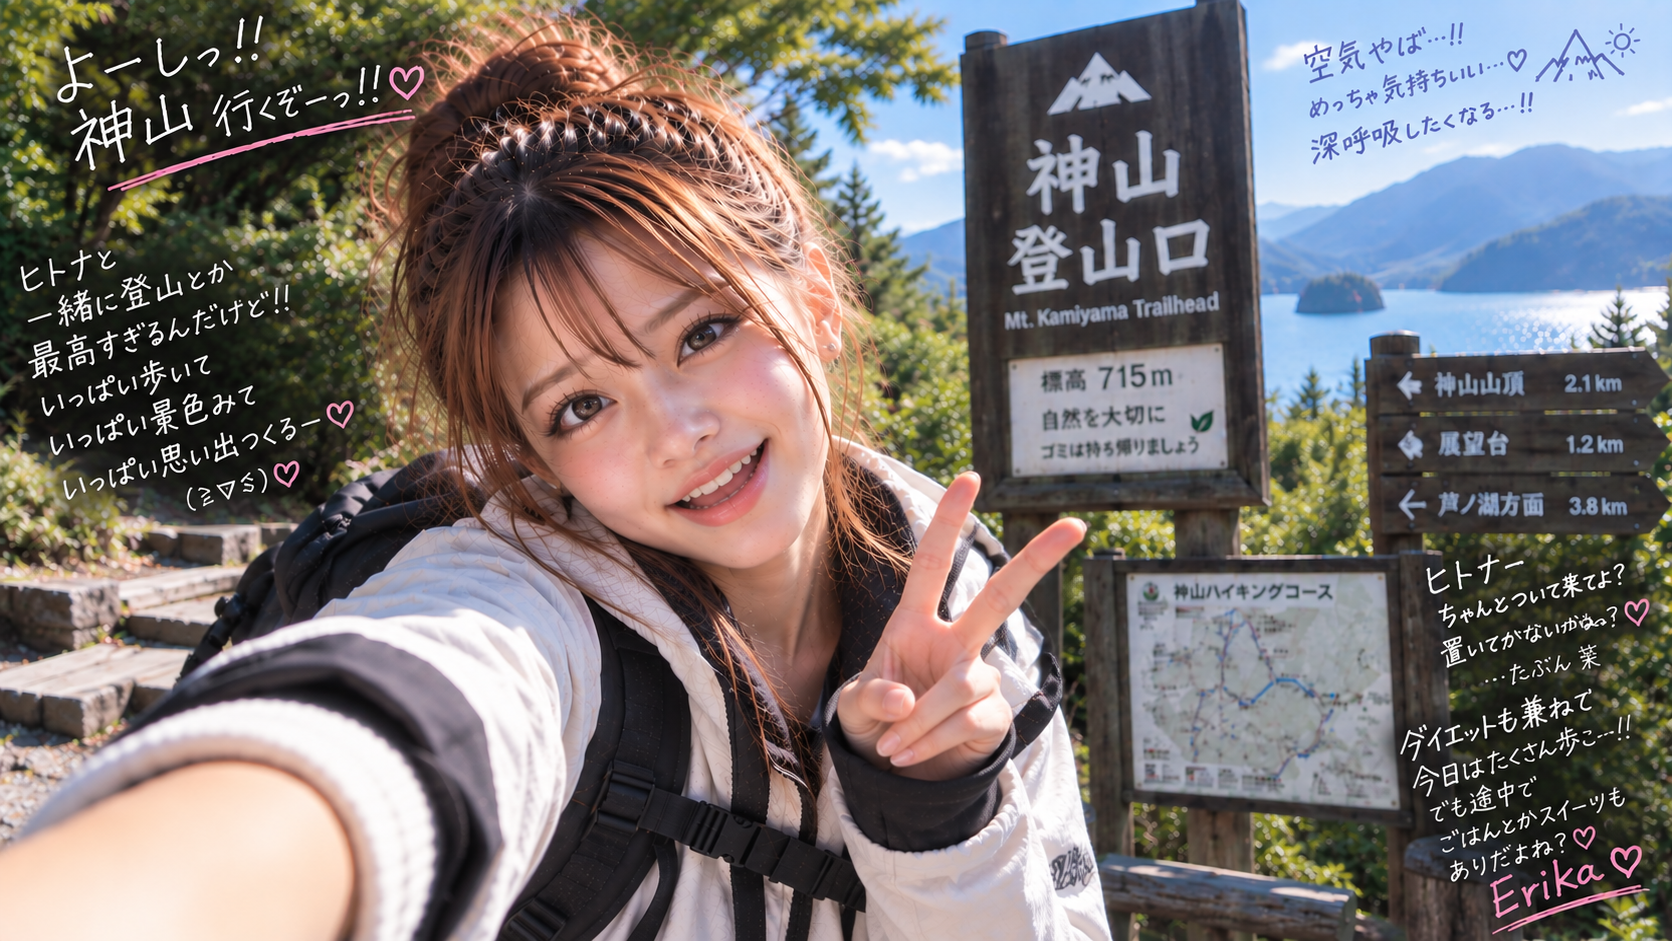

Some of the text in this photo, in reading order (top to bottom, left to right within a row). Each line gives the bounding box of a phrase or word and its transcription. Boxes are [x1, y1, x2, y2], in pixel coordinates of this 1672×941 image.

[1026, 130, 1181, 216] 神山
[1007, 218, 1211, 296] 登山口
[1004, 291, 1220, 331] Mt. Kamiyama Trailhead
[1041, 368, 1087, 393] 標高
[1434, 370, 1525, 398] 神山山頂
[1042, 405, 1166, 432] 自然を大切に
[1041, 436, 1200, 460] ゴミは持ち帰りましょう
[1438, 430, 1510, 457] 展望台
[1174, 582, 1334, 601] 神山ハイキングコース
